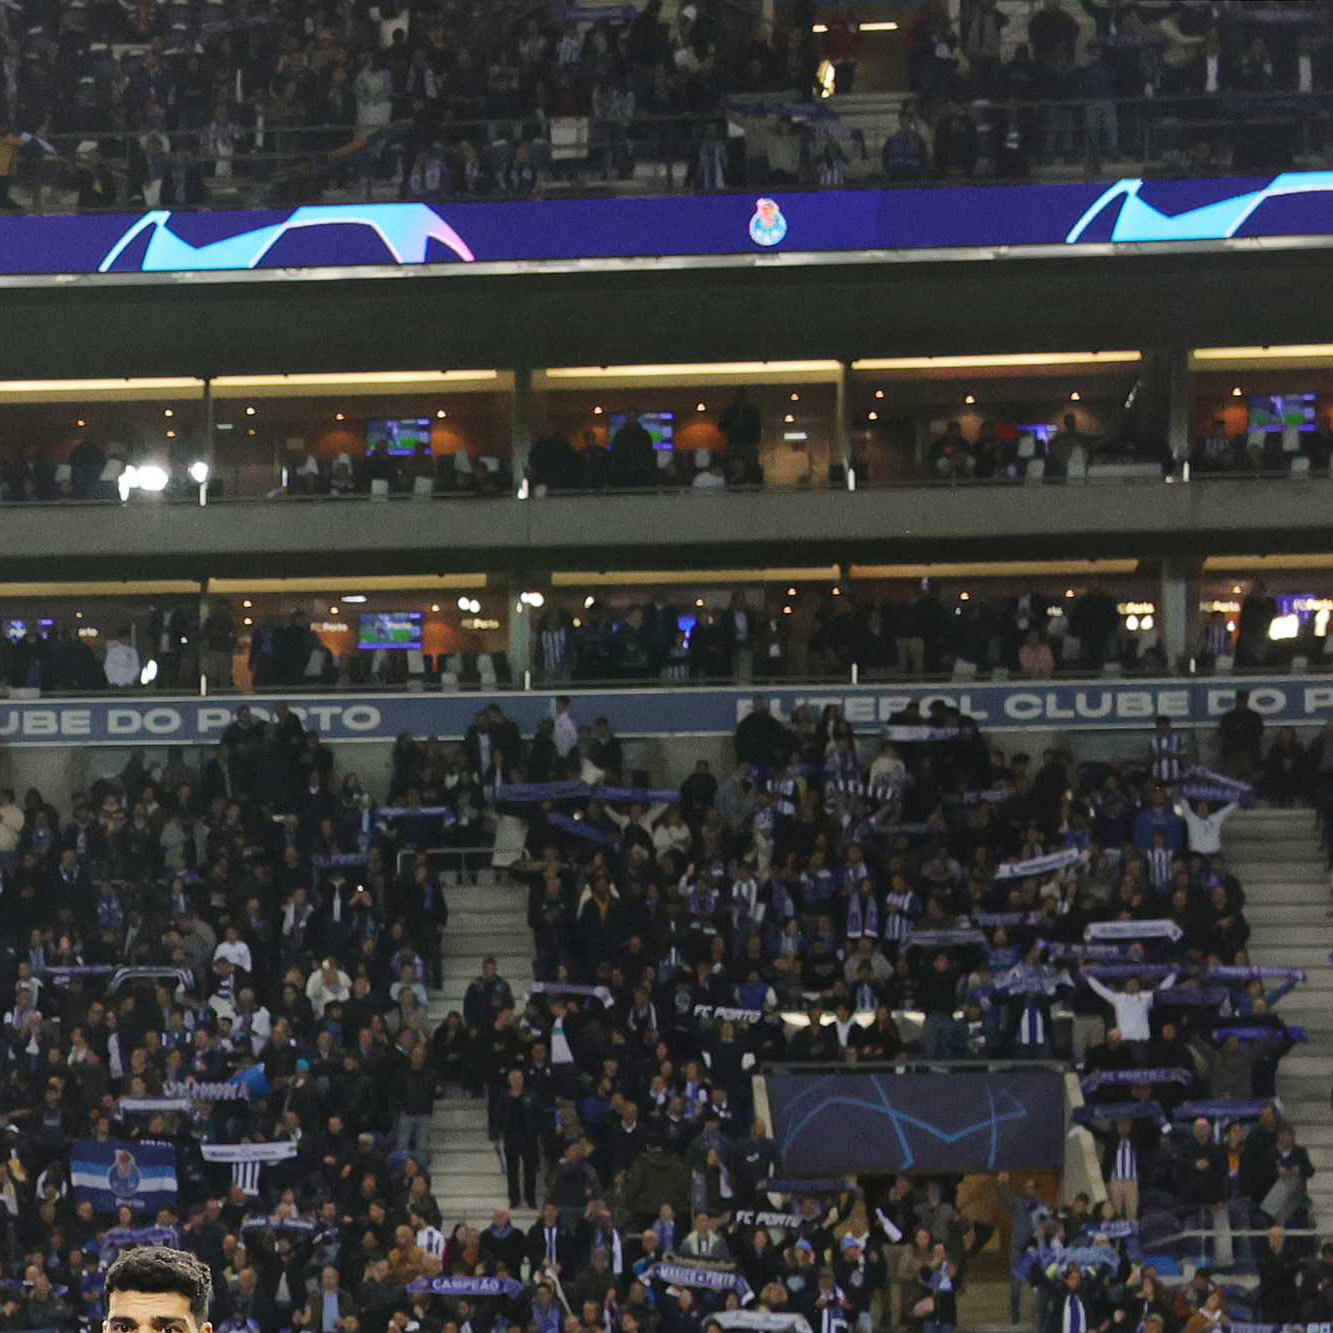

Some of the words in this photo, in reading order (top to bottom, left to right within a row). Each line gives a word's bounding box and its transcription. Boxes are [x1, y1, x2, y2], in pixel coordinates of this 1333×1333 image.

[1003, 692, 1191, 720] CLUBE
[106, 706, 181, 735] DO
[693, 1003, 712, 1018] FC
[735, 1210, 754, 1225] FC
[432, 1276, 501, 1291] CAMPEÃO
